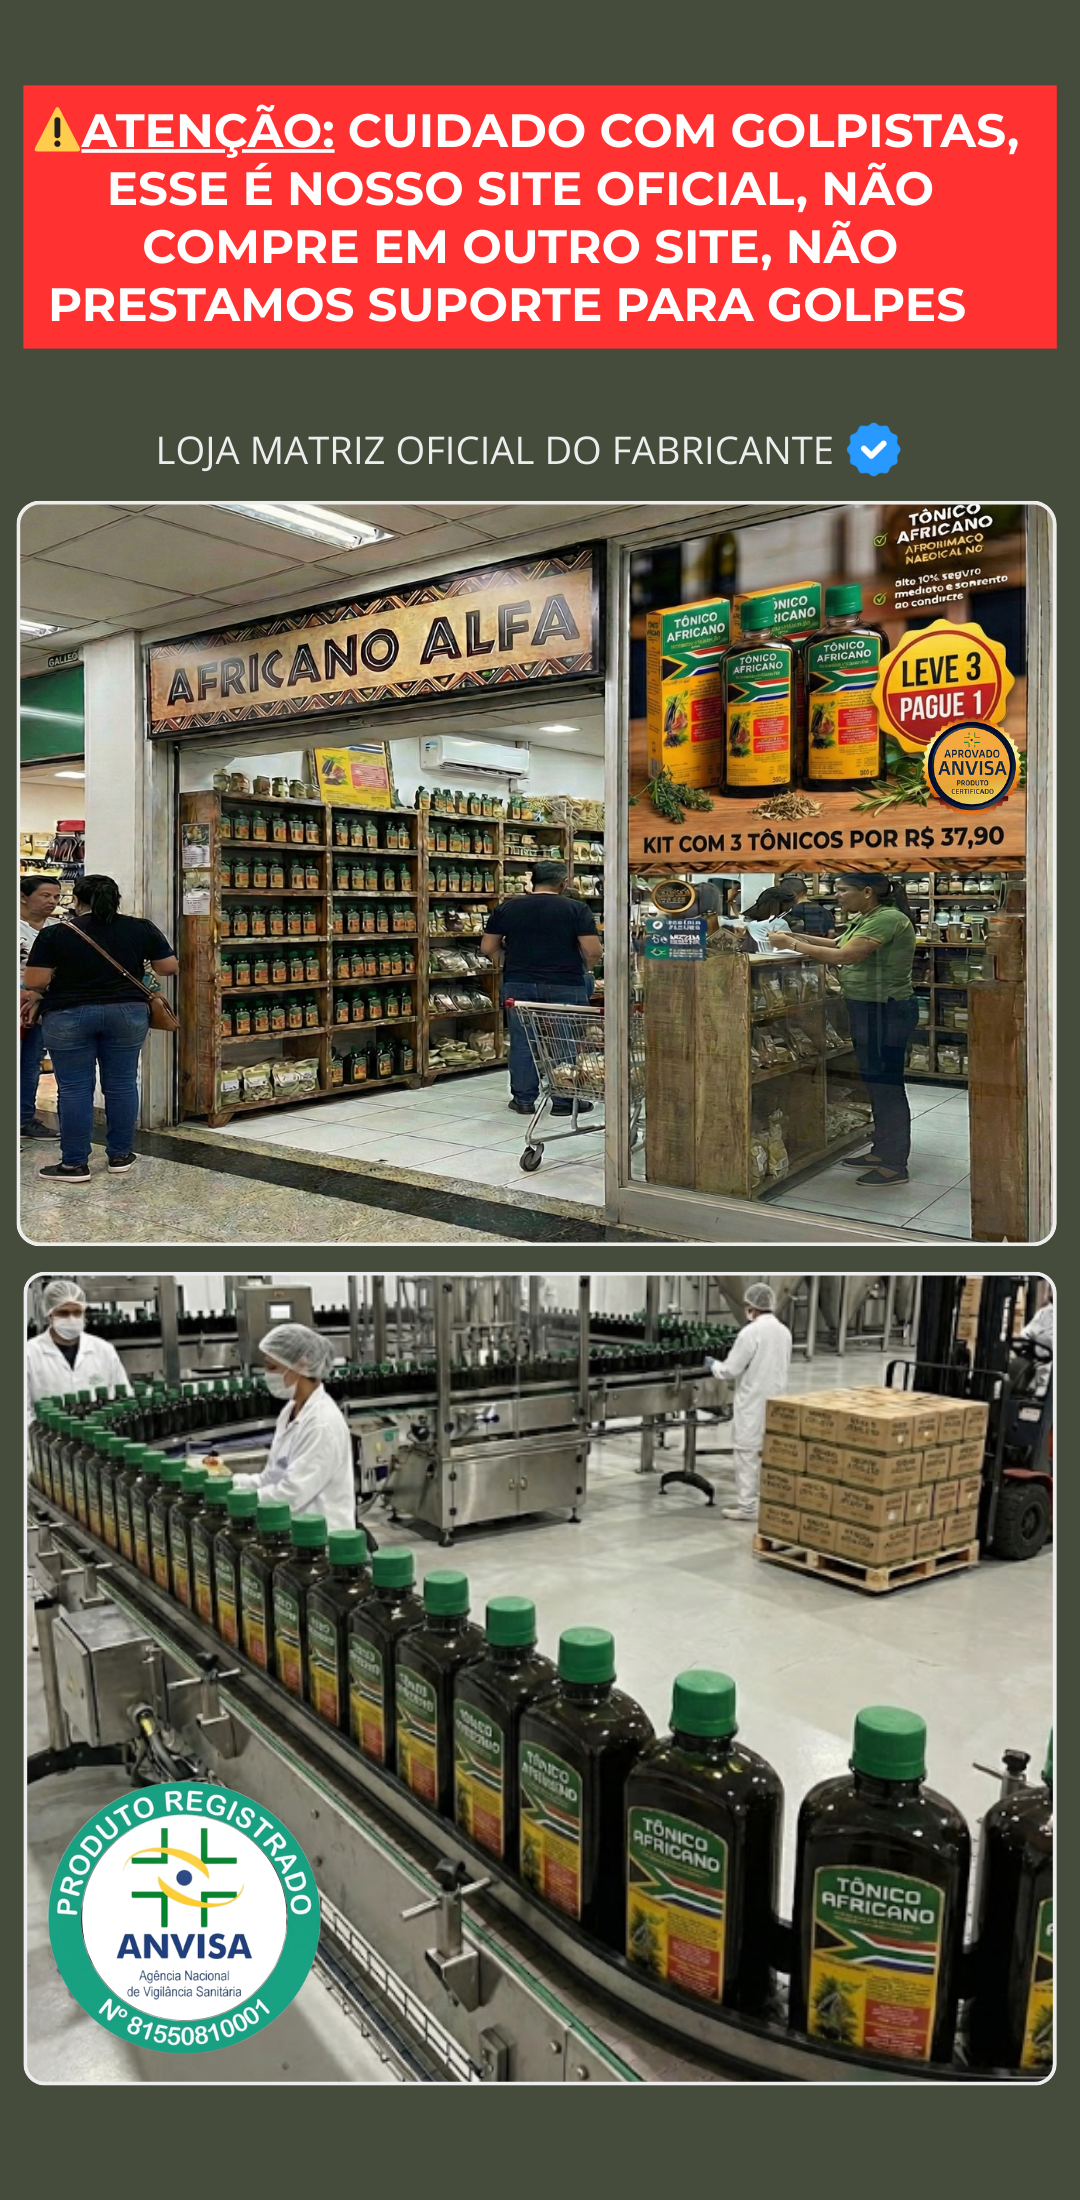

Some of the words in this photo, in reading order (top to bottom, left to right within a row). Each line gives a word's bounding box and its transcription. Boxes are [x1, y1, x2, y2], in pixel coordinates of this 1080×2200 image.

[909, 503, 981, 526] TÔNICO
[897, 515, 993, 544] AFRICANO
[667, 623, 726, 643] AFRICANO
[674, 612, 718, 629] TÔNICO
[167, 628, 399, 706] AFRICANO
[420, 594, 580, 665] ALFA
[740, 653, 777, 665] TÔNICO
[817, 649, 872, 663] AFRICANO
[823, 640, 865, 653] TÔNICO
[733, 661, 783, 675] AFRICANO
[902, 654, 959, 687] LEVE
[966, 652, 981, 681] 3
[900, 692, 965, 722] PAGUE
[973, 690, 982, 715] 1
[944, 750, 1000, 759] APROVADO
[938, 760, 1007, 776] ANVISA
[644, 836, 674, 853] KIT
[679, 834, 725, 852] COM
[731, 834, 742, 851] 3
[748, 828, 844, 850] TÔNICOS
[851, 830, 898, 848] POR
[905, 826, 934, 849] R$
[941, 825, 1005, 849] 37,90
[642, 1816, 708, 1852] TÔNICO
[633, 1829, 720, 1873] AFRICANO
[837, 1876, 921, 1905] TÔNICO
[822, 1891, 935, 1924] AFRICANO
